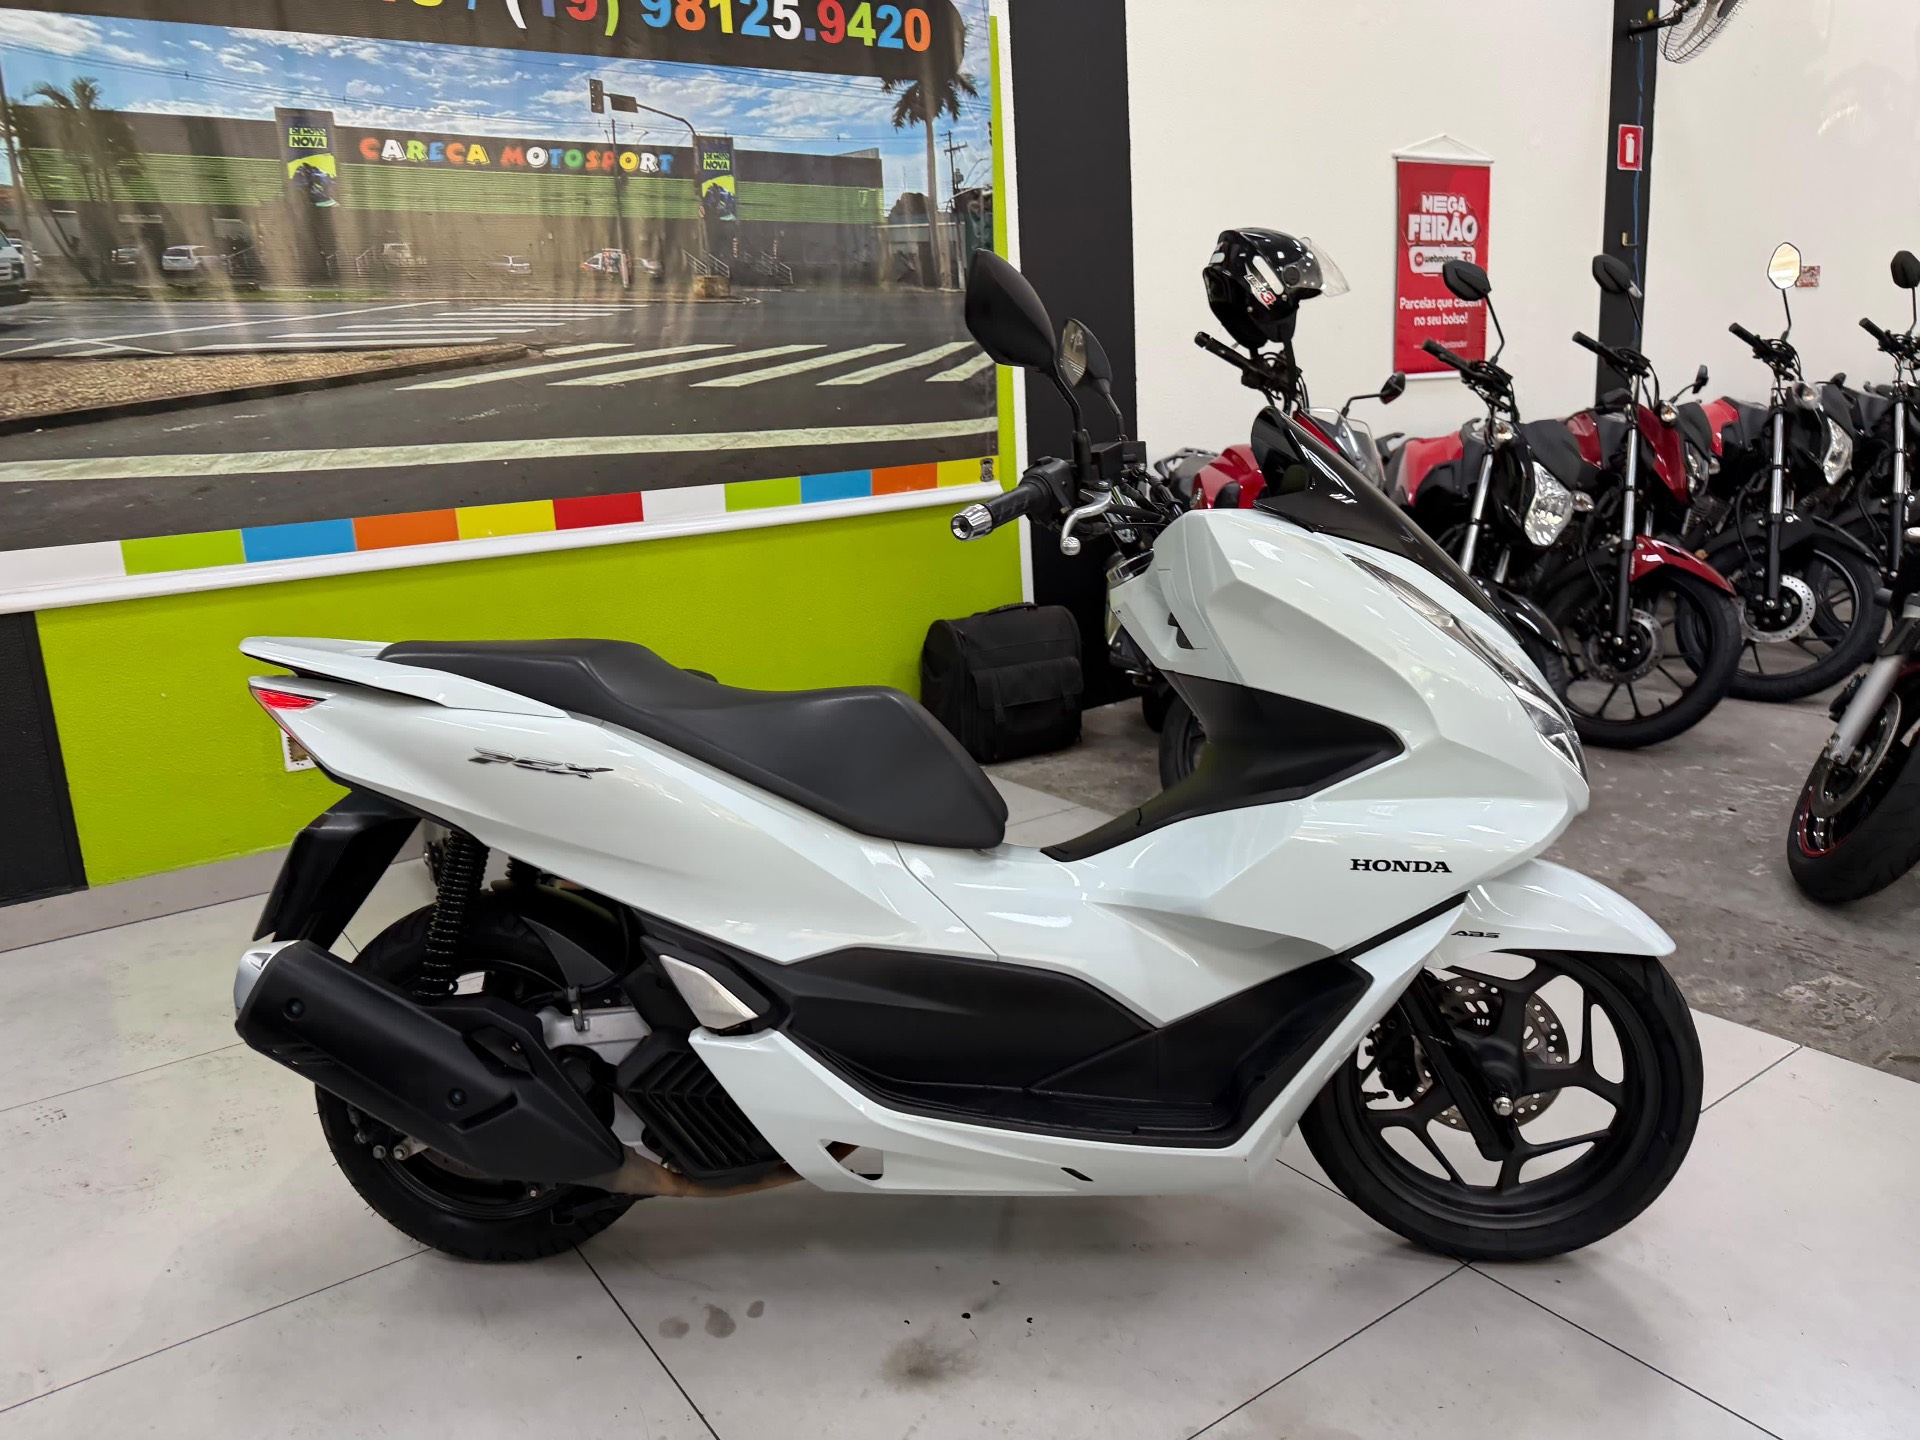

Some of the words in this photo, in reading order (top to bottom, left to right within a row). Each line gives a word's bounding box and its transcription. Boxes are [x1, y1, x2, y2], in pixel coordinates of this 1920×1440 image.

[640, 0, 931, 52] 98125.9420
[291, 136, 326, 148] NOVA
[359, 137, 491, 165] CARECA
[500, 146, 674, 174] MOTOSPORT
[705, 160, 729, 170] NOVA
[1421, 194, 1467, 214] MEGA
[1408, 211, 1478, 243] FEIRÃO
[1399, 296, 1436, 310] Parcelas
[1437, 299, 1453, 311] que
[1413, 316, 1426, 327] no
[1427, 315, 1442, 326] seu
[1442, 311, 1469, 325] bolso!
[1350, 858, 1453, 874] HONDA
[1451, 930, 1501, 939] ABS
